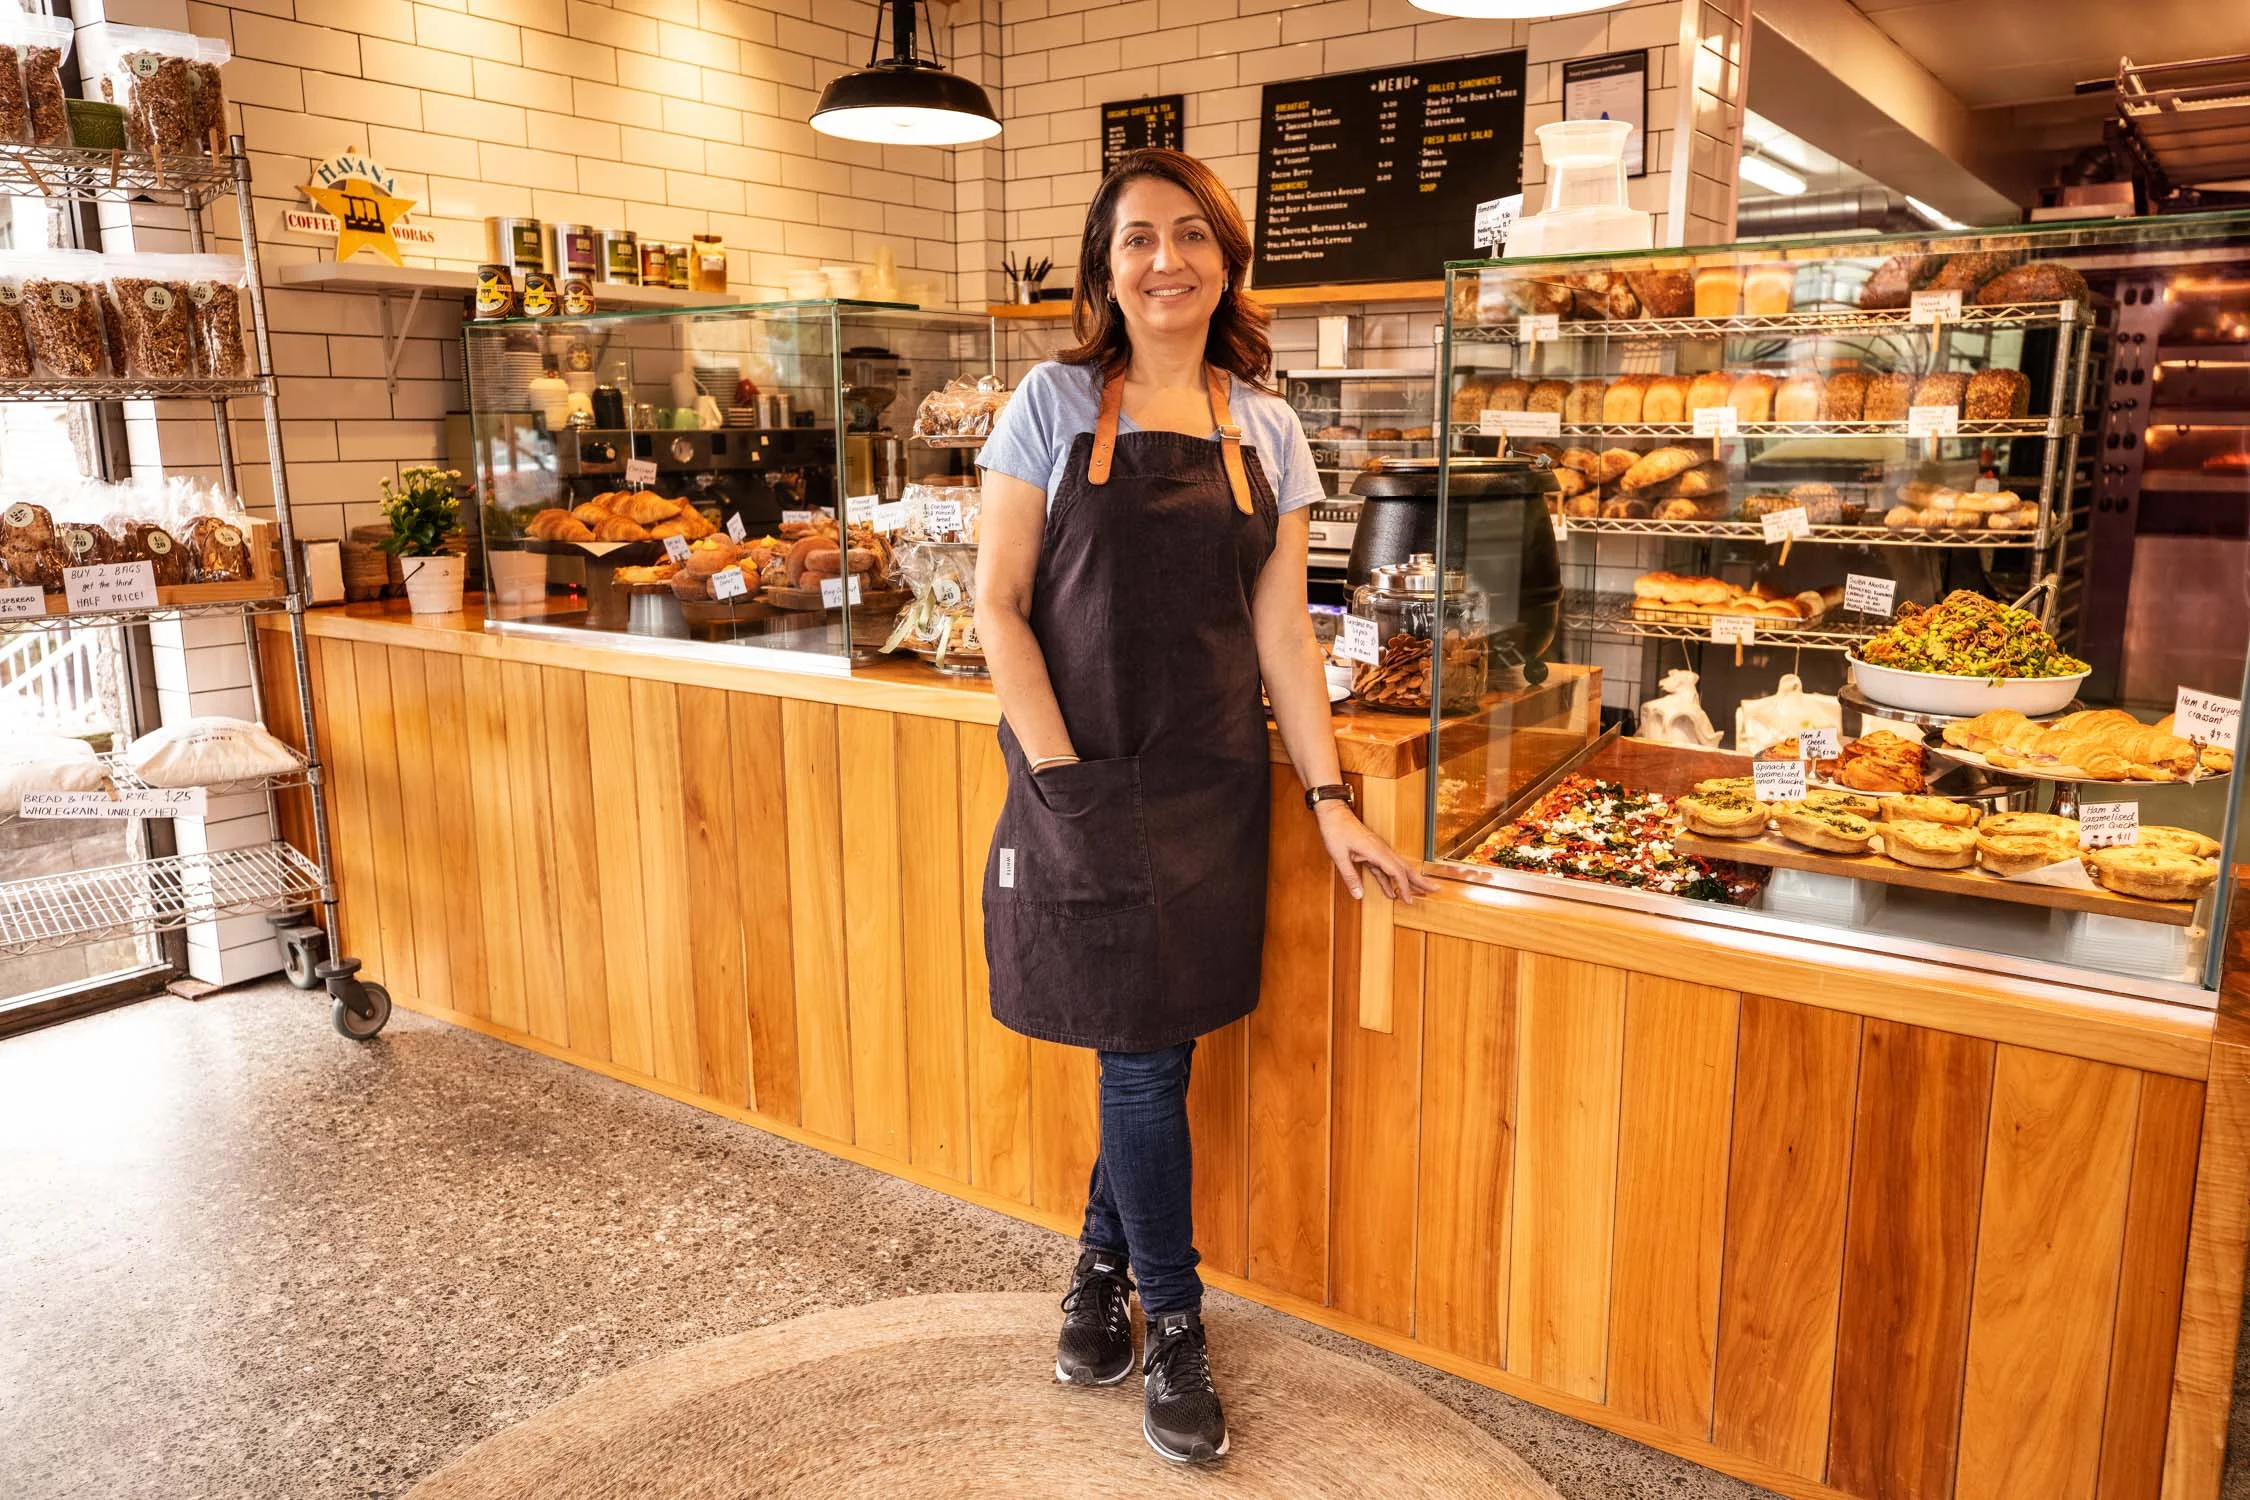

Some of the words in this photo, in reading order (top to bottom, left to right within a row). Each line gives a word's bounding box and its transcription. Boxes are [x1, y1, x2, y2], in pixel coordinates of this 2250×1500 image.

[1378, 76, 1411, 92] MENU
[1427, 81, 1456, 93] GRILLED
[1459, 75, 1502, 89] SANDWICHES
[1423, 136, 1445, 145] FRESH
[1448, 132, 1468, 143] DAILY
[1470, 129, 1493, 140] SALAD
[318, 157, 393, 193] HAVANA
[1419, 183, 1437, 192] SOUP
[288, 214, 338, 232] COFFEE
[392, 226, 434, 243] WORKS
[71, 569, 90, 580] BUY
[98, 568, 105, 576] 2
[115, 564, 141, 575] BAGS
[82, 581, 94, 592] get
[100, 580, 110, 589] the
[116, 578, 133, 586] third
[77, 596, 100, 608] HALF
[2181, 696, 2198, 708] Ham
[1801, 732, 1813, 740] Ham
[1755, 763, 1786, 771] Spinach
[24, 794, 62, 803] BREAD
[165, 790, 193, 802] $25
[107, 807, 178, 816] UNBLEACHED
[2087, 806, 2107, 814] Ham
[2081, 812, 2136, 823] caramelised
[2081, 824, 2104, 832] onion
[2117, 832, 2131, 842] $11
